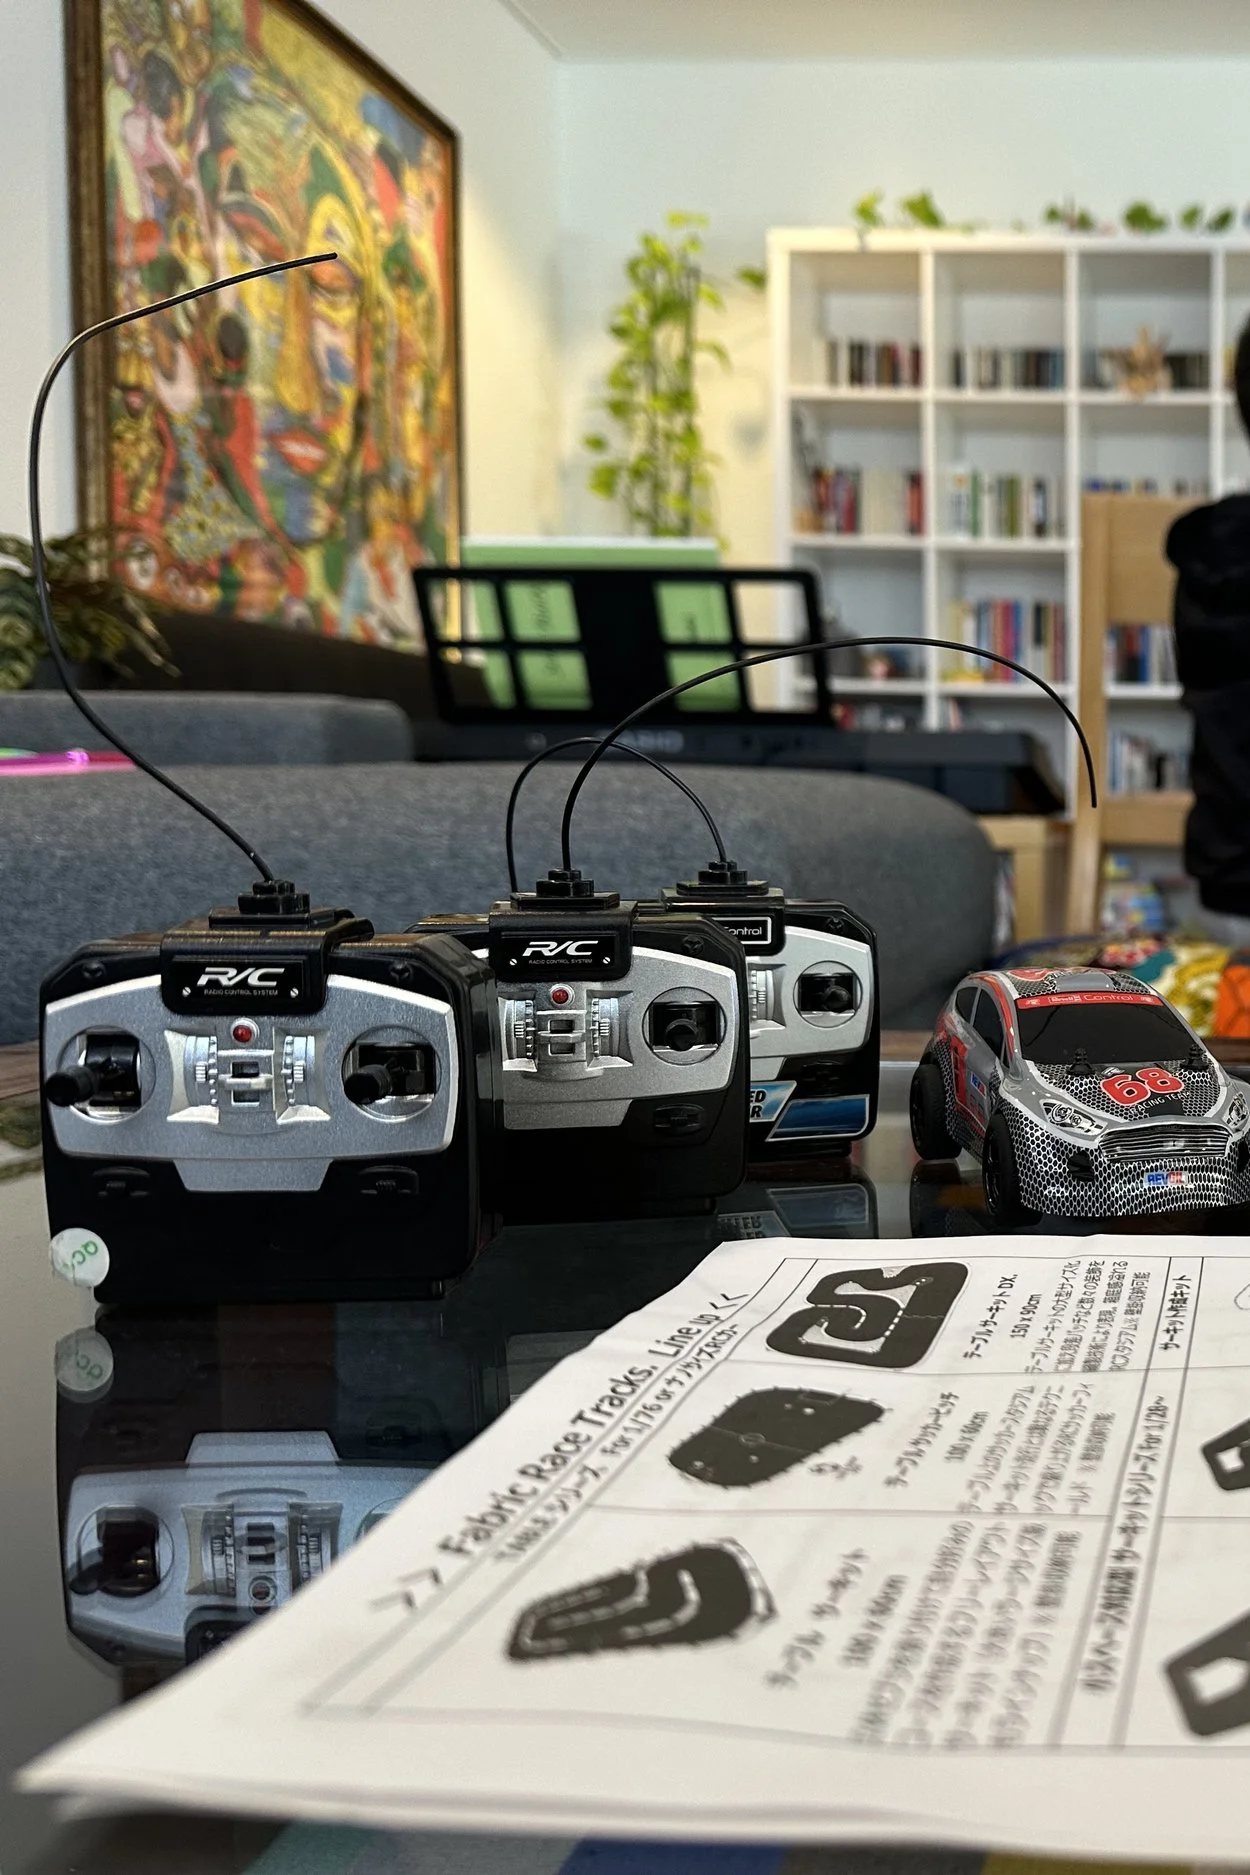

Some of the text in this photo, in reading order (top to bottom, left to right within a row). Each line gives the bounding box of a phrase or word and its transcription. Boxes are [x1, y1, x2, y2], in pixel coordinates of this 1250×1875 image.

[522, 940, 599, 957] R/C
[196, 966, 286, 987] R/C
[224, 988, 252, 996] CONTROL
[252, 989, 279, 997] SYSTEM
[1083, 993, 1134, 1002] Control
[1100, 1067, 1185, 1107] 68
[1129, 1090, 1192, 1114] RACING TEAM
[1019, 1293, 1042, 1315] 90cm
[1010, 1323, 1030, 1338] 150
[601, 1432, 633, 1457] For
[626, 1400, 664, 1438] 1/76
[655, 1388, 675, 1403] or
[437, 1480, 538, 1556] Fabric
[517, 1430, 590, 1482] Race
[570, 1364, 658, 1428] Tracks.
[648, 1322, 702, 1359] Line
[692, 1311, 724, 1330] up
[1137, 1433, 1163, 1451] For
